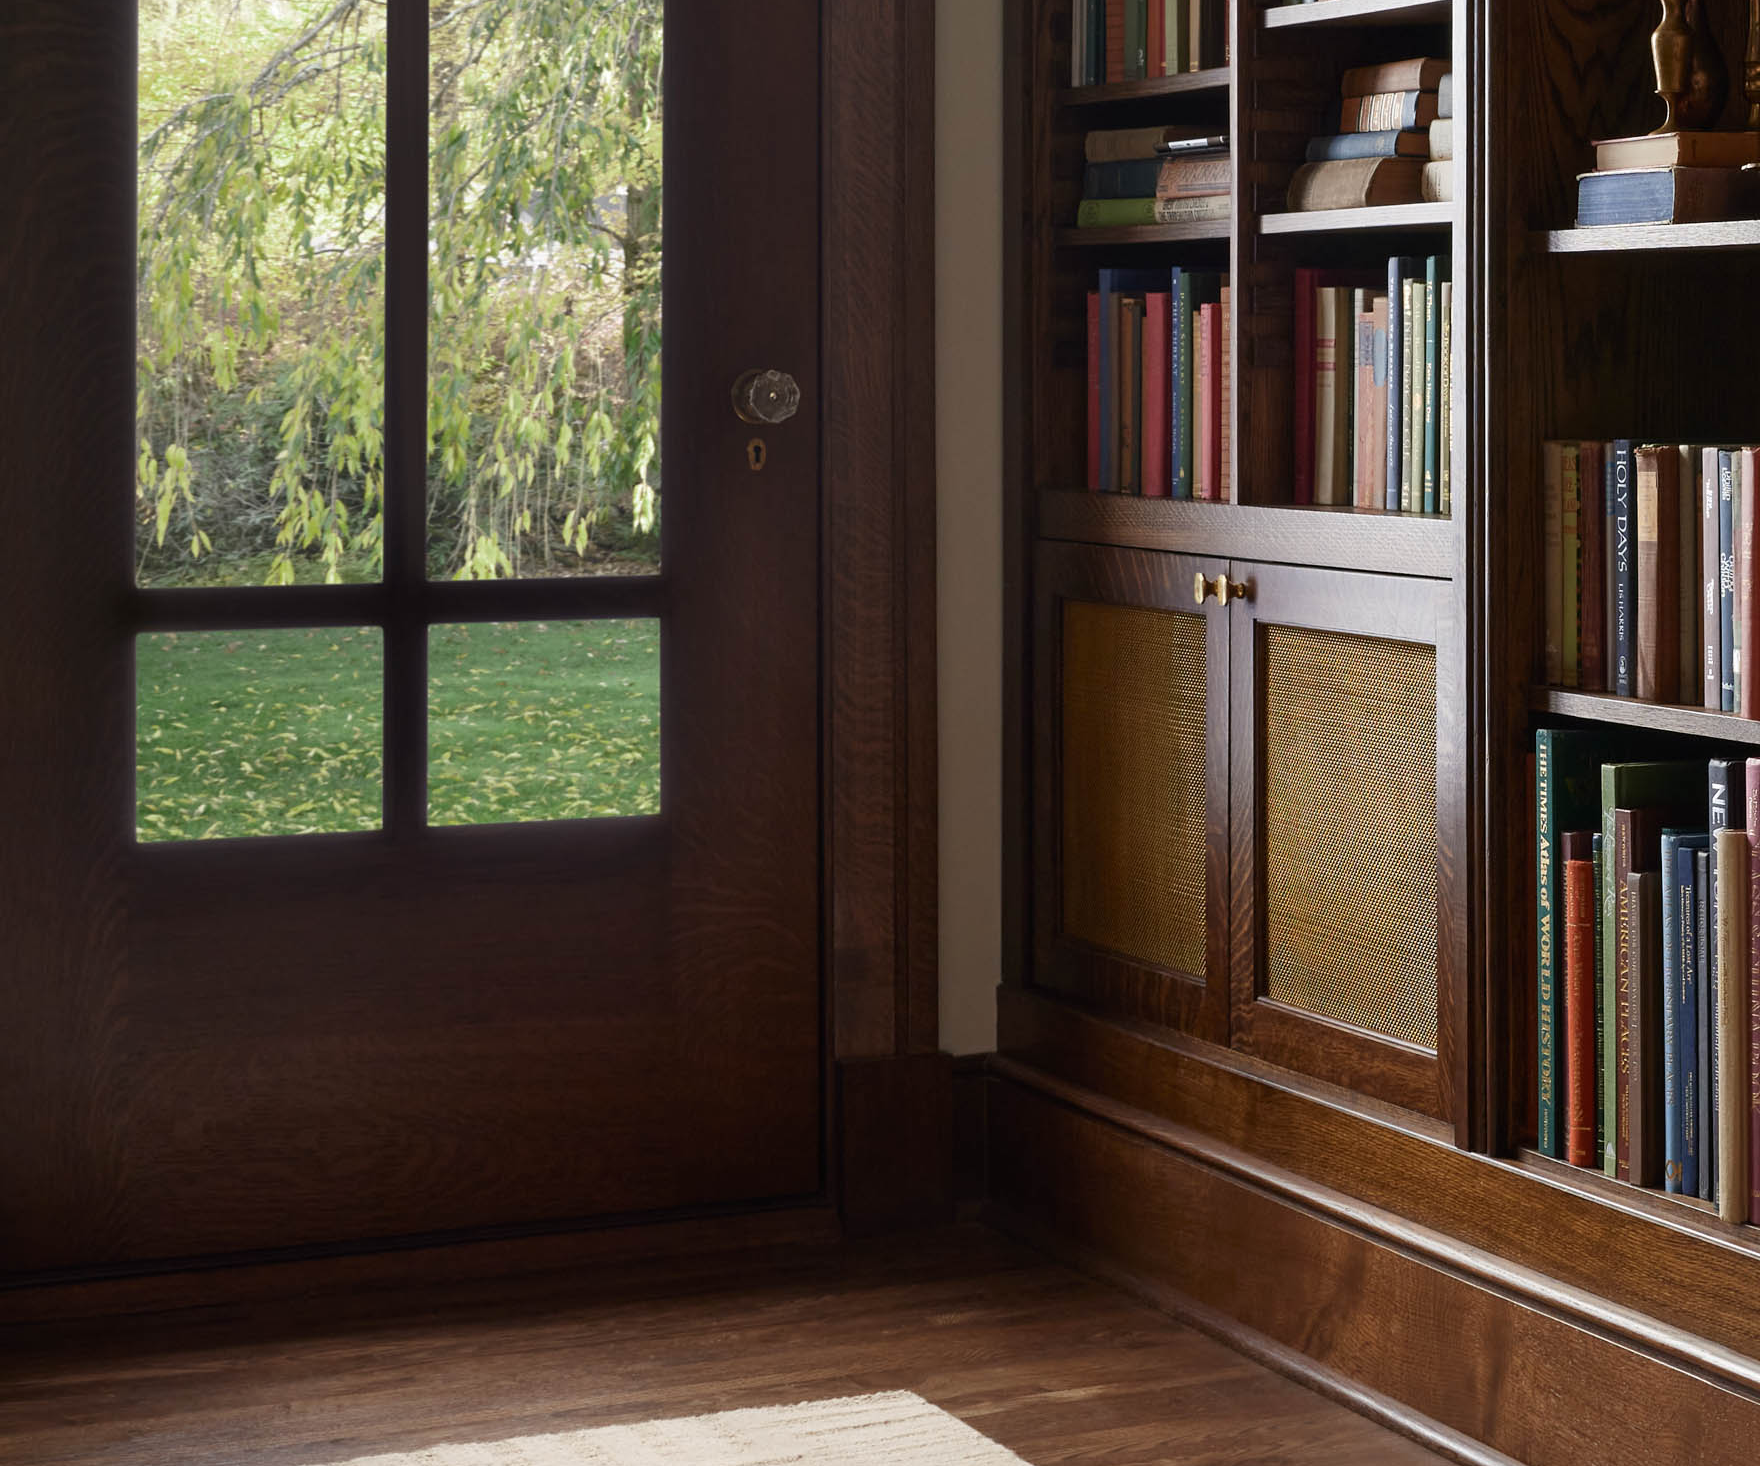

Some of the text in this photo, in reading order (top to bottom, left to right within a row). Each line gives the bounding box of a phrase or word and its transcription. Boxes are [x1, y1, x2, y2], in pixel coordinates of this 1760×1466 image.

[1616, 450, 1627, 572] HOLY DAYS
[1540, 743, 1549, 834] THE TIMES
[1711, 783, 1726, 852] NEW
[1685, 884, 1693, 925] Treasures
[1540, 835, 1550, 1105] Atlas of WORLD HISTORY
[1619, 879, 1630, 1075] AMERICAN PLACES
